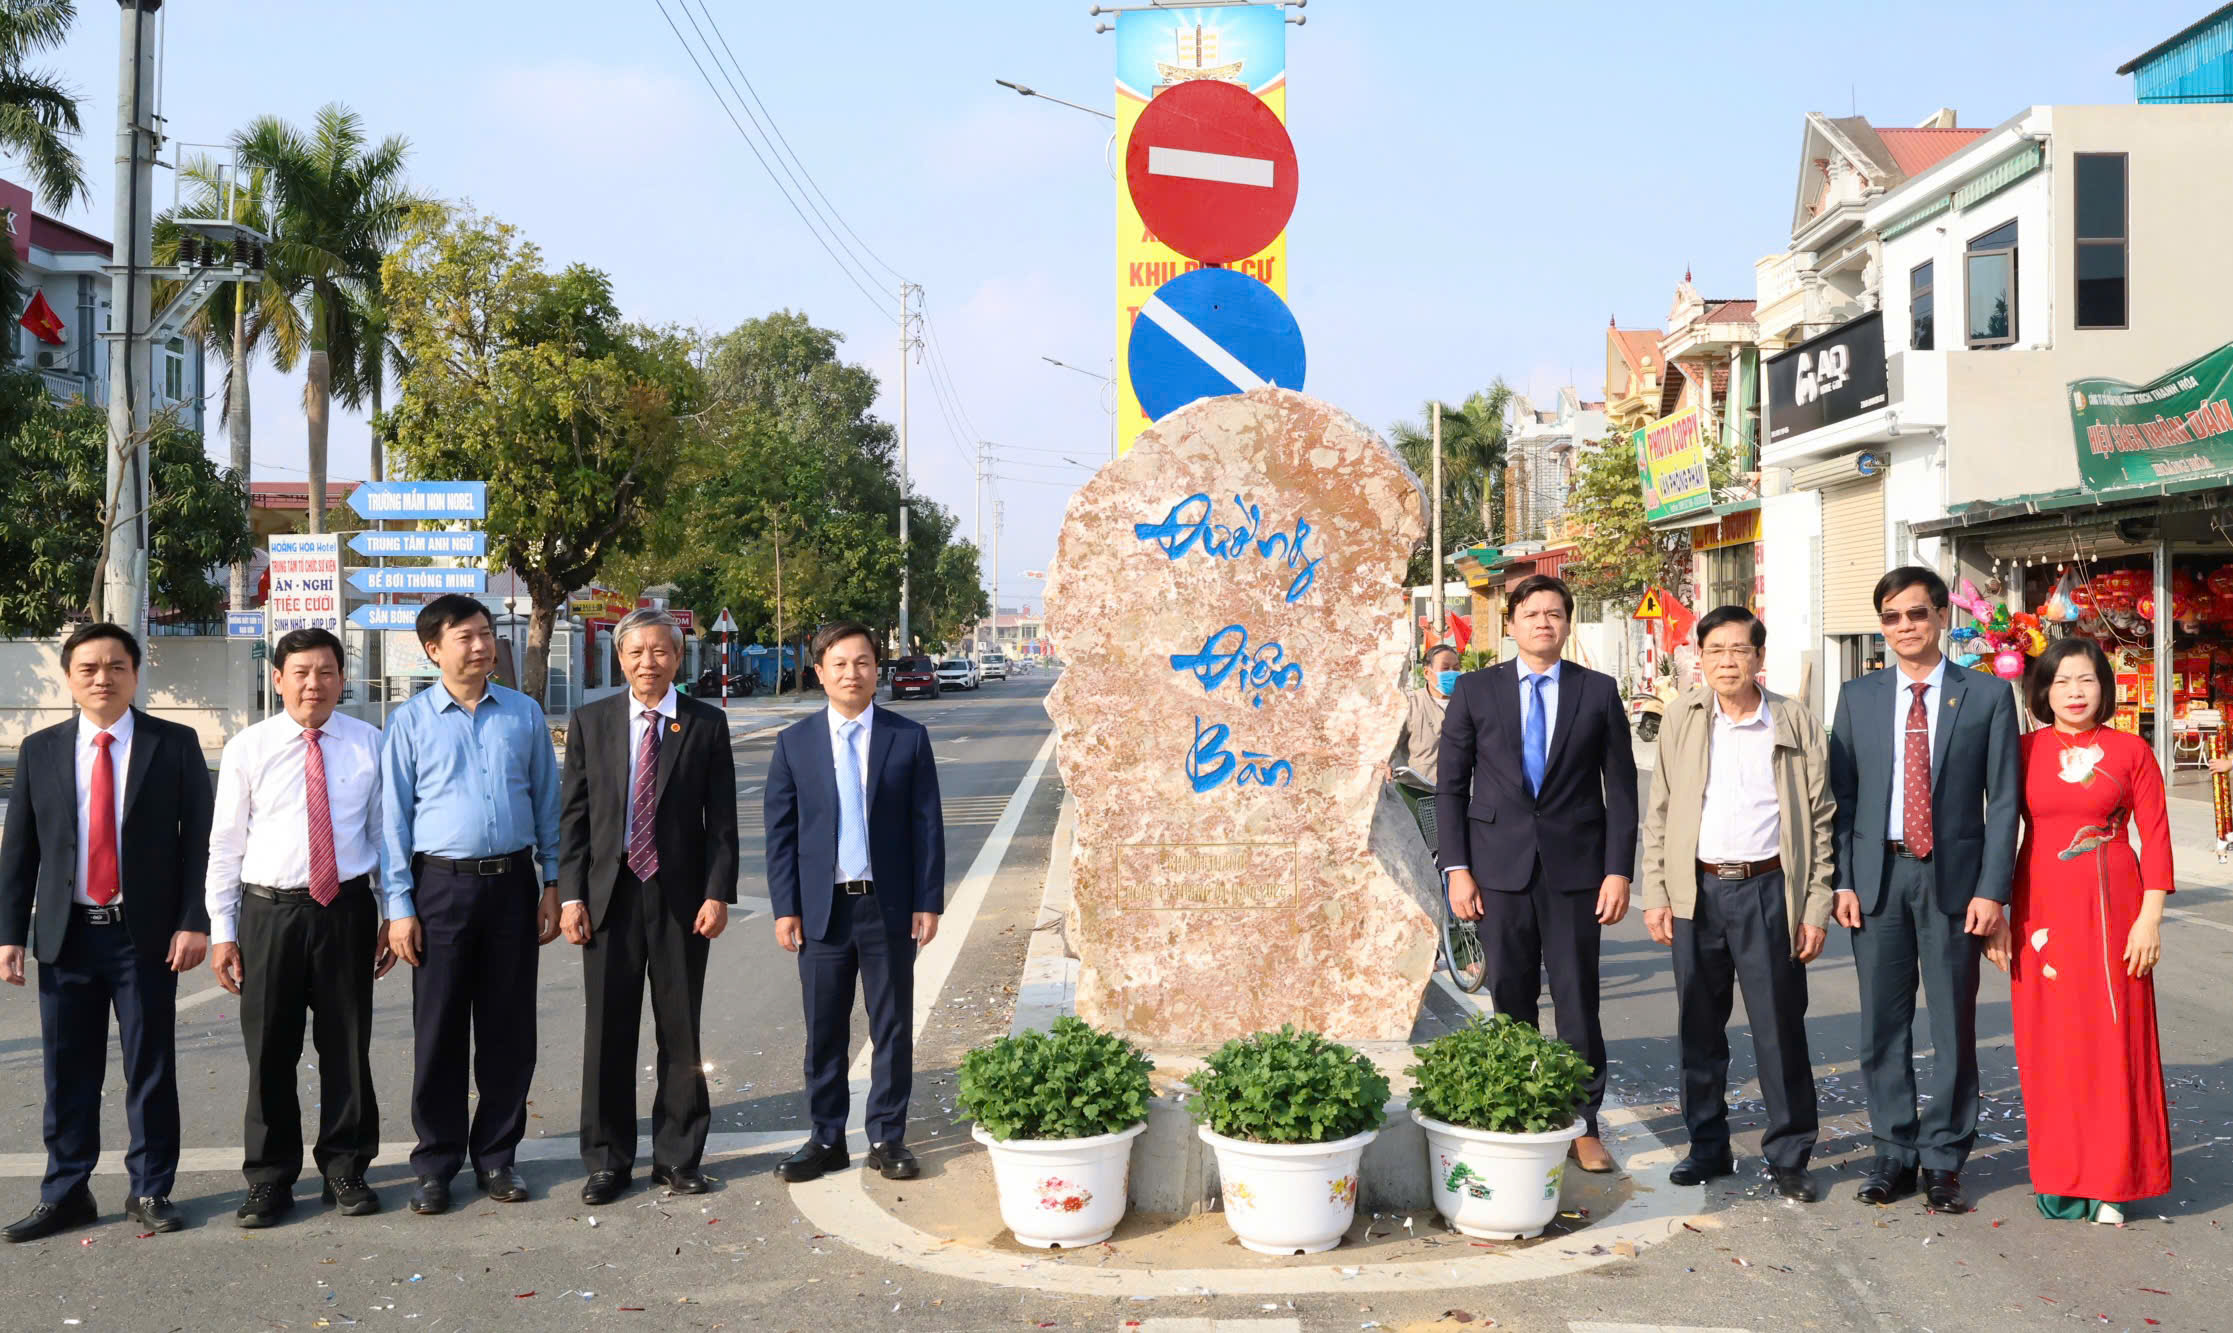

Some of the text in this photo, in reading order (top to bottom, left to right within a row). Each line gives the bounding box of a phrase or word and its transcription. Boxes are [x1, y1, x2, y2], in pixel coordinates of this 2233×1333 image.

[2150, 383, 2180, 401] THANH
[2177, 375, 2200, 392] HÓA
[1647, 412, 1700, 461] PHOTO COPPY
[2087, 418, 2114, 460] HIỆU
[2109, 416, 2149, 452] SÁCH
[2138, 414, 2193, 449] NHÂN
[1668, 466, 1689, 496] PHÒNG
[367, 488, 402, 511] TRƯỜNG
[426, 492, 445, 511] NON
[447, 492, 475, 511] NOBEL
[317, 542, 337, 552] Hotel
[367, 534, 475, 551] TRUNG TÂM ANH NGỮ
[1134, 492, 1325, 603] Đường
[275, 578, 293, 591] ĂN
[302, 576, 334, 591] NGHỈ
[385, 573, 403, 588] BƠI
[407, 571, 443, 588] THÔNG
[445, 573, 475, 588] MINH
[273, 593, 334, 615] TIỆC CƯỚI
[368, 607, 416, 624] SÂN BÓNG
[274, 618, 288, 631] SINH
[1170, 624, 1304, 710] Điện
[1185, 714, 1294, 793] Bàn
